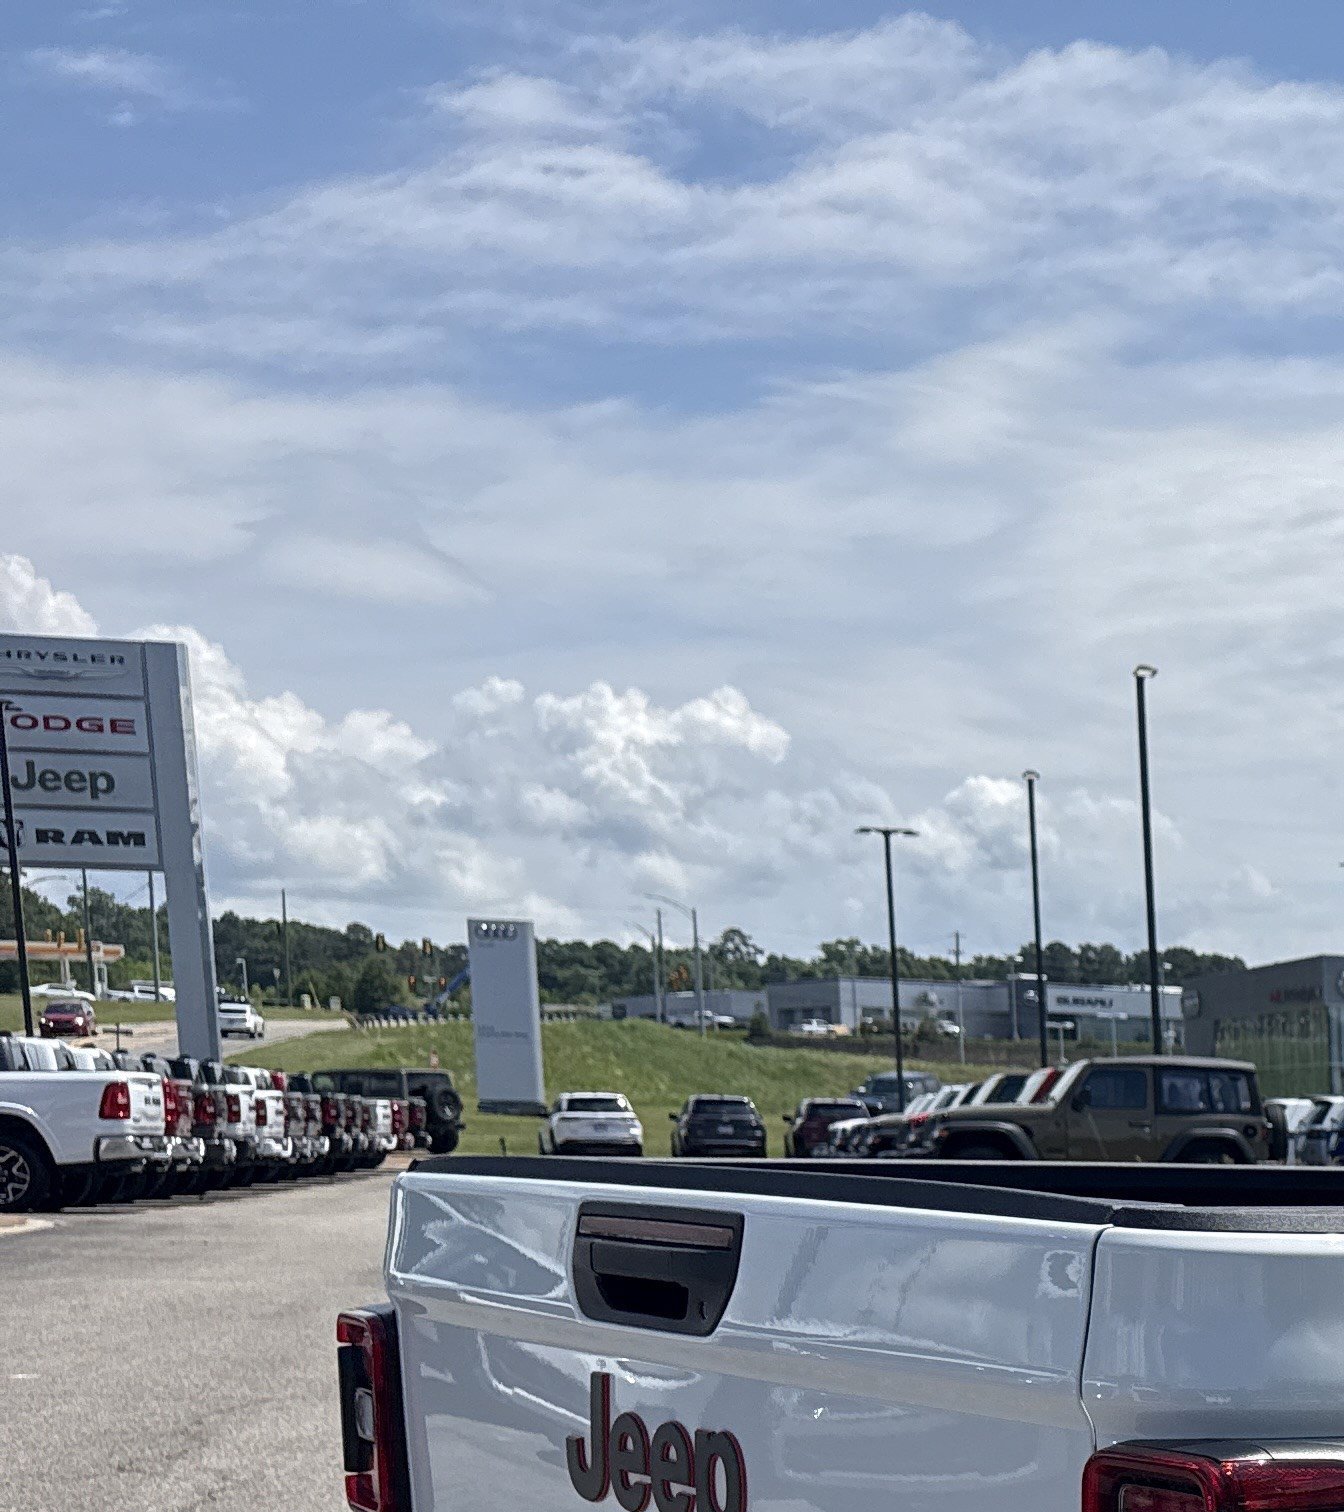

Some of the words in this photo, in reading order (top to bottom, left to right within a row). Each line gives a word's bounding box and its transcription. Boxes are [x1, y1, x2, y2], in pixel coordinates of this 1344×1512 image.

[10, 713, 136, 736] ODGE
[11, 759, 116, 799] Jeep
[35, 827, 147, 848] RAM
